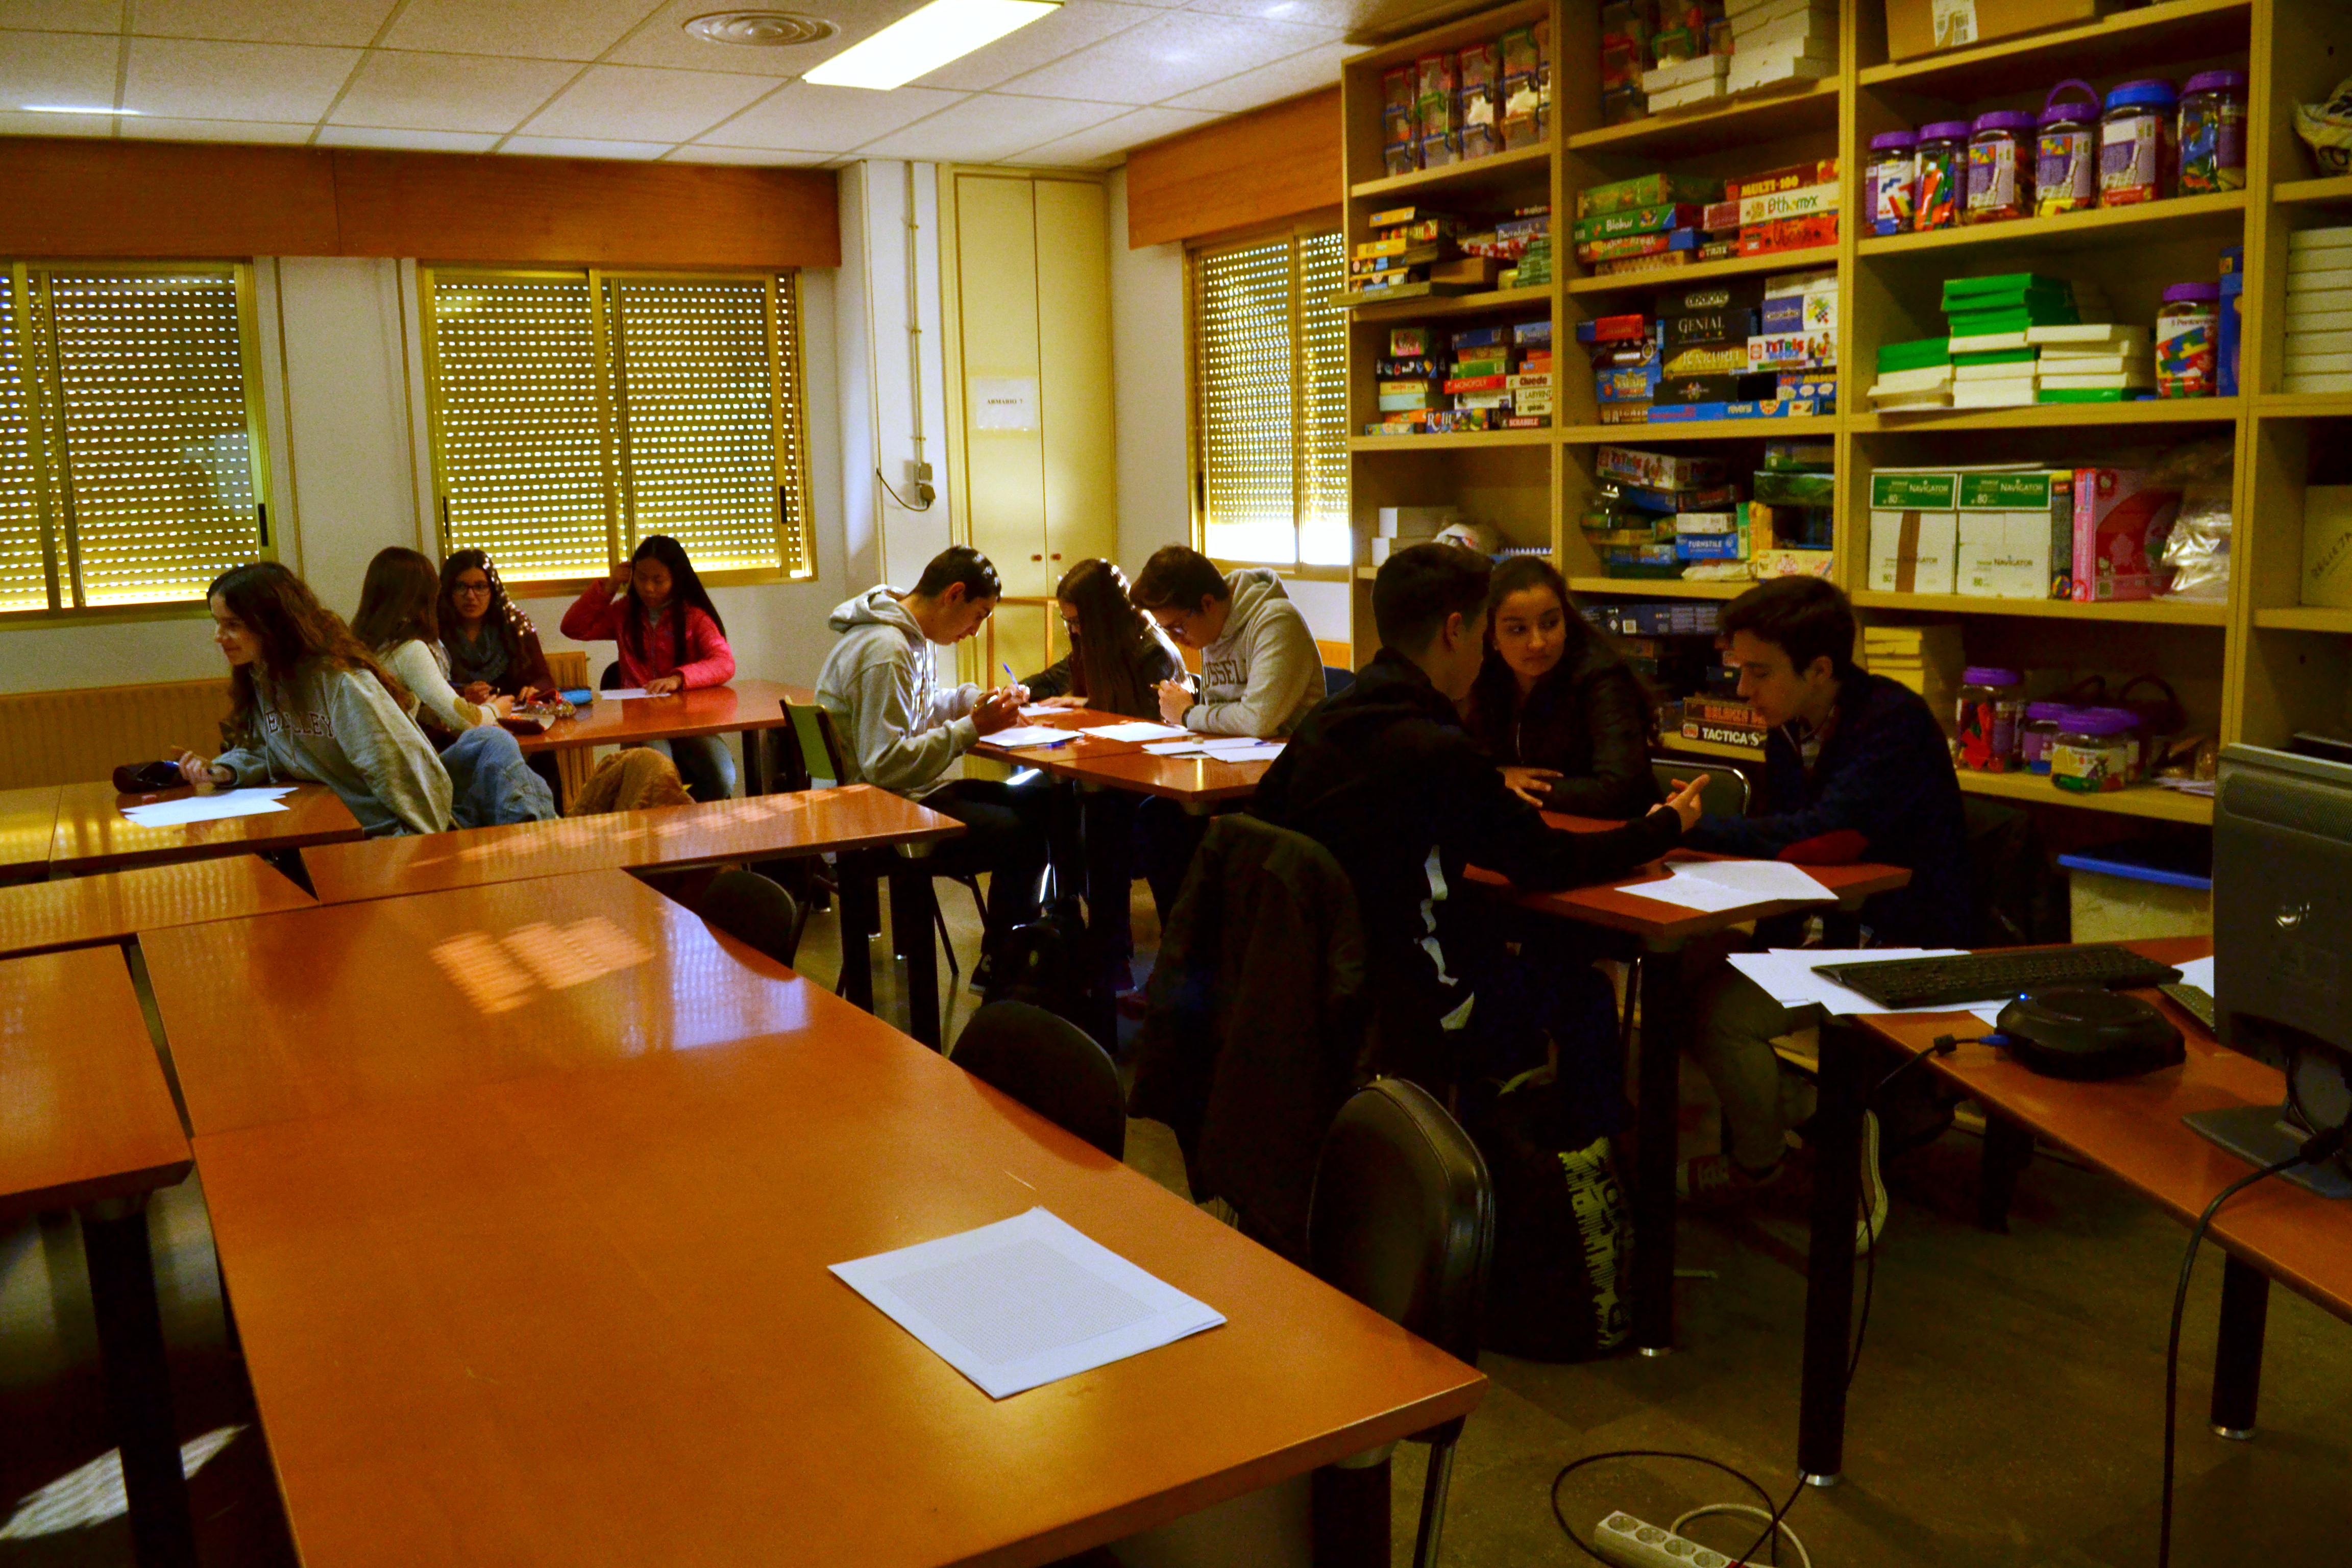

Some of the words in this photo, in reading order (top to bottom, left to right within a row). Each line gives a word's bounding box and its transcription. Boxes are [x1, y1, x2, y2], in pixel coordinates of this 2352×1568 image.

[1454, 379, 1487, 389] MONOPOLY
[1508, 418, 1539, 427] SCRABBLE
[1909, 484, 1949, 493] NAVIGATOR
[2000, 483, 2044, 493] NAVIGATOR
